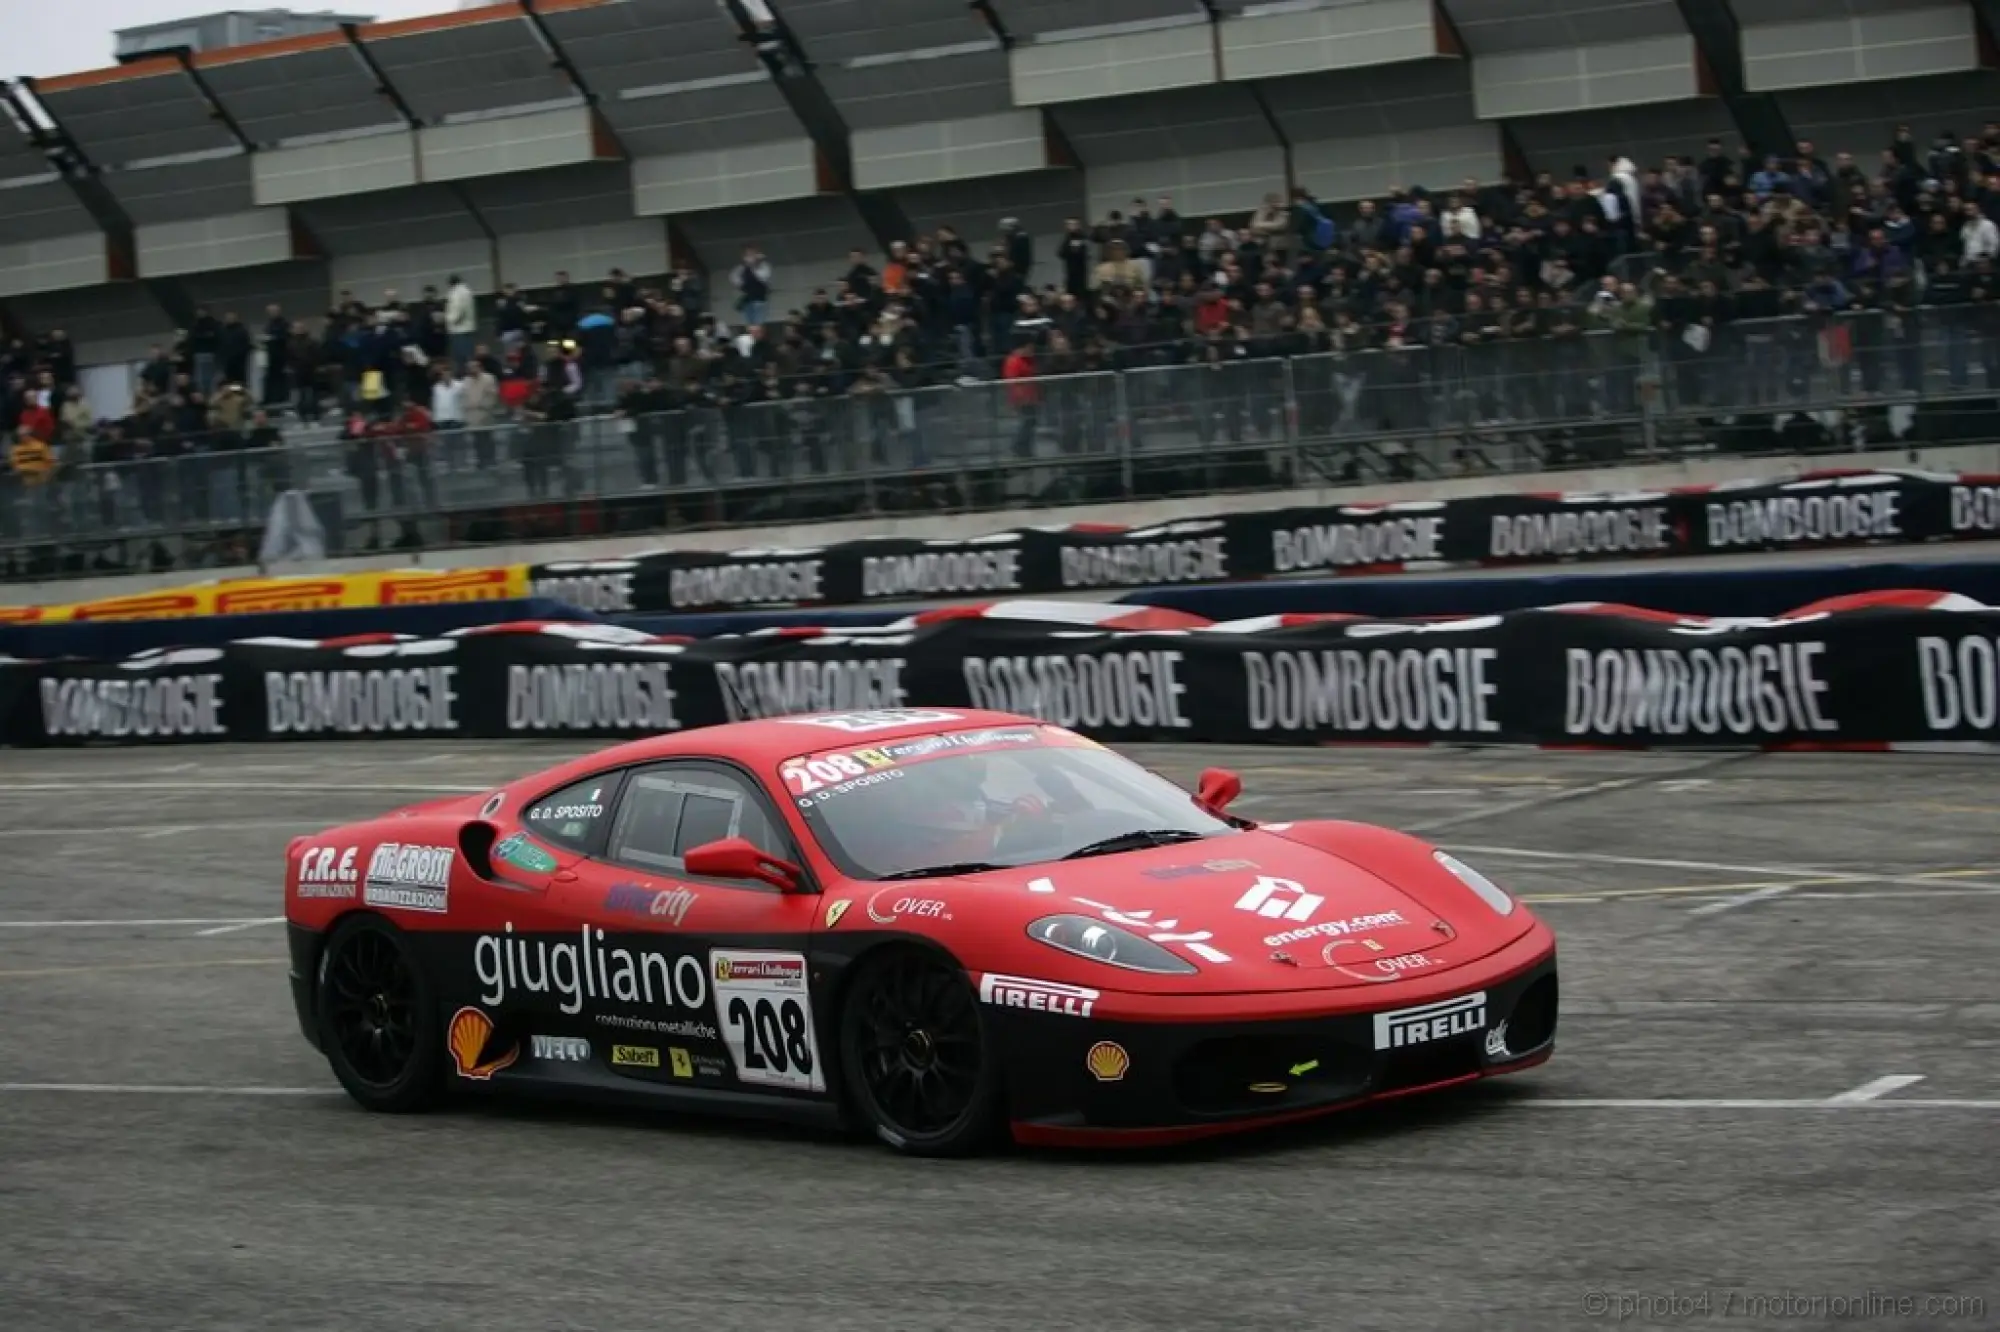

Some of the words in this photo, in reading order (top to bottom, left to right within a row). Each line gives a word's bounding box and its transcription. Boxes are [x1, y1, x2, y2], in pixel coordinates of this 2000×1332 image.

[1492, 508, 1670, 559] BOMBOOGIE
[1708, 491, 1901, 546] BOMBOOGIE
[1951, 485, 2000, 530] BO
[1061, 537, 1228, 585] BOMBOOGIE
[1273, 518, 1445, 570] BOMBOOGIE
[669, 559, 824, 607] BOMBOOGIE
[862, 549, 1022, 596] BOMBOOGIE
[41, 674, 227, 735] BOMBOOGIE
[266, 666, 458, 733] BOMBOOGIE
[507, 660, 681, 730] BOMBOOGIE
[963, 650, 1192, 729] BOMBOOGIE
[1243, 647, 1498, 732] BOMBOOGIE
[1565, 642, 1839, 733] BOMBOOGIE
[1918, 635, 2000, 729] BO
[783, 753, 867, 793] 208
[836, 769, 904, 794] SPOSITO
[554, 804, 603, 819] SPOSITO
[1263, 909, 1404, 947] energy.com
[474, 921, 706, 1014] giugliano
[980, 973, 1100, 1018] PIRELLI
[1373, 991, 1487, 1050] PIRELLI
[729, 997, 814, 1075] 208
